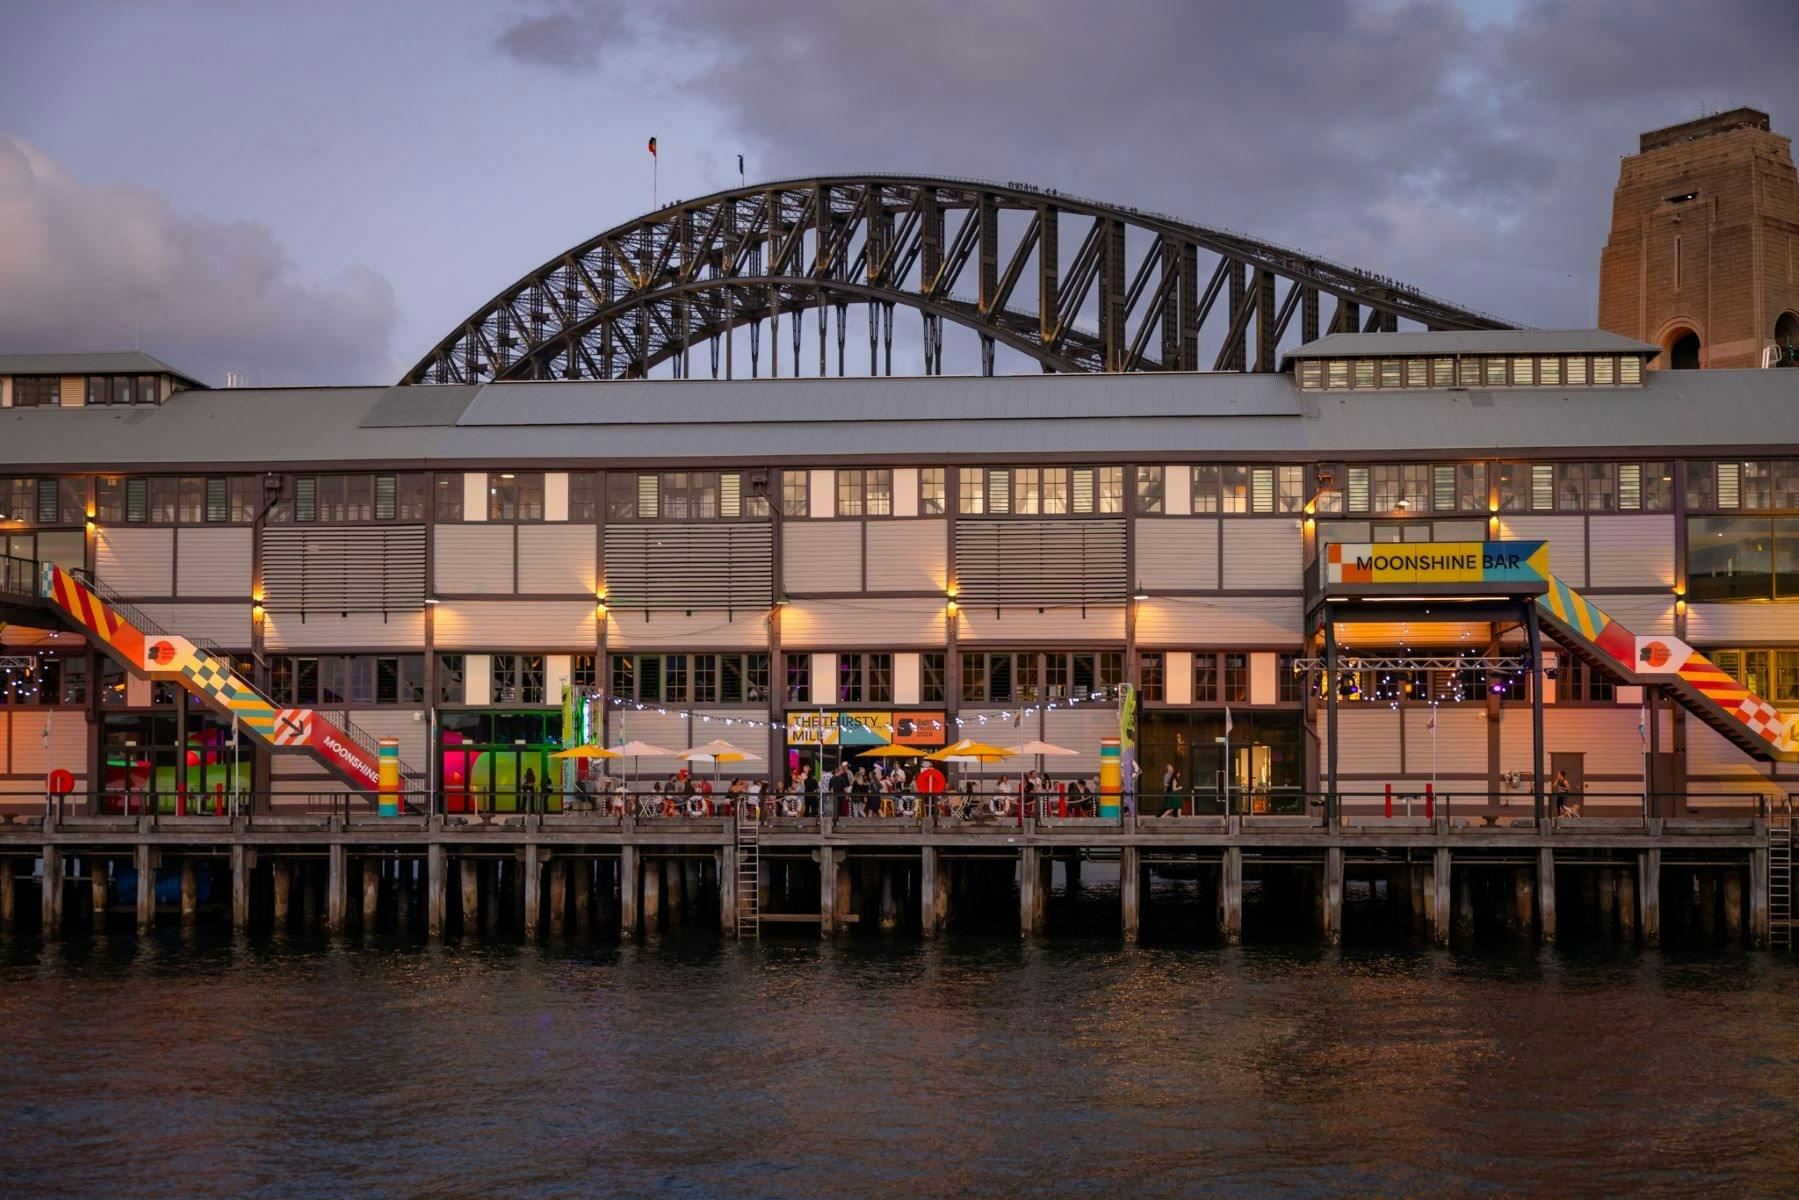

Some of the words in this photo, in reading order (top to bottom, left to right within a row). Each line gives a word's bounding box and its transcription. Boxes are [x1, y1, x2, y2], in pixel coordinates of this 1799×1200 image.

[1356, 554, 1476, 571] MOONSHINE
[1482, 553, 1520, 569] BAR
[793, 716, 819, 727] THE
[821, 716, 878, 727] THIRSTY
[323, 735, 380, 784] MOONSHINE
